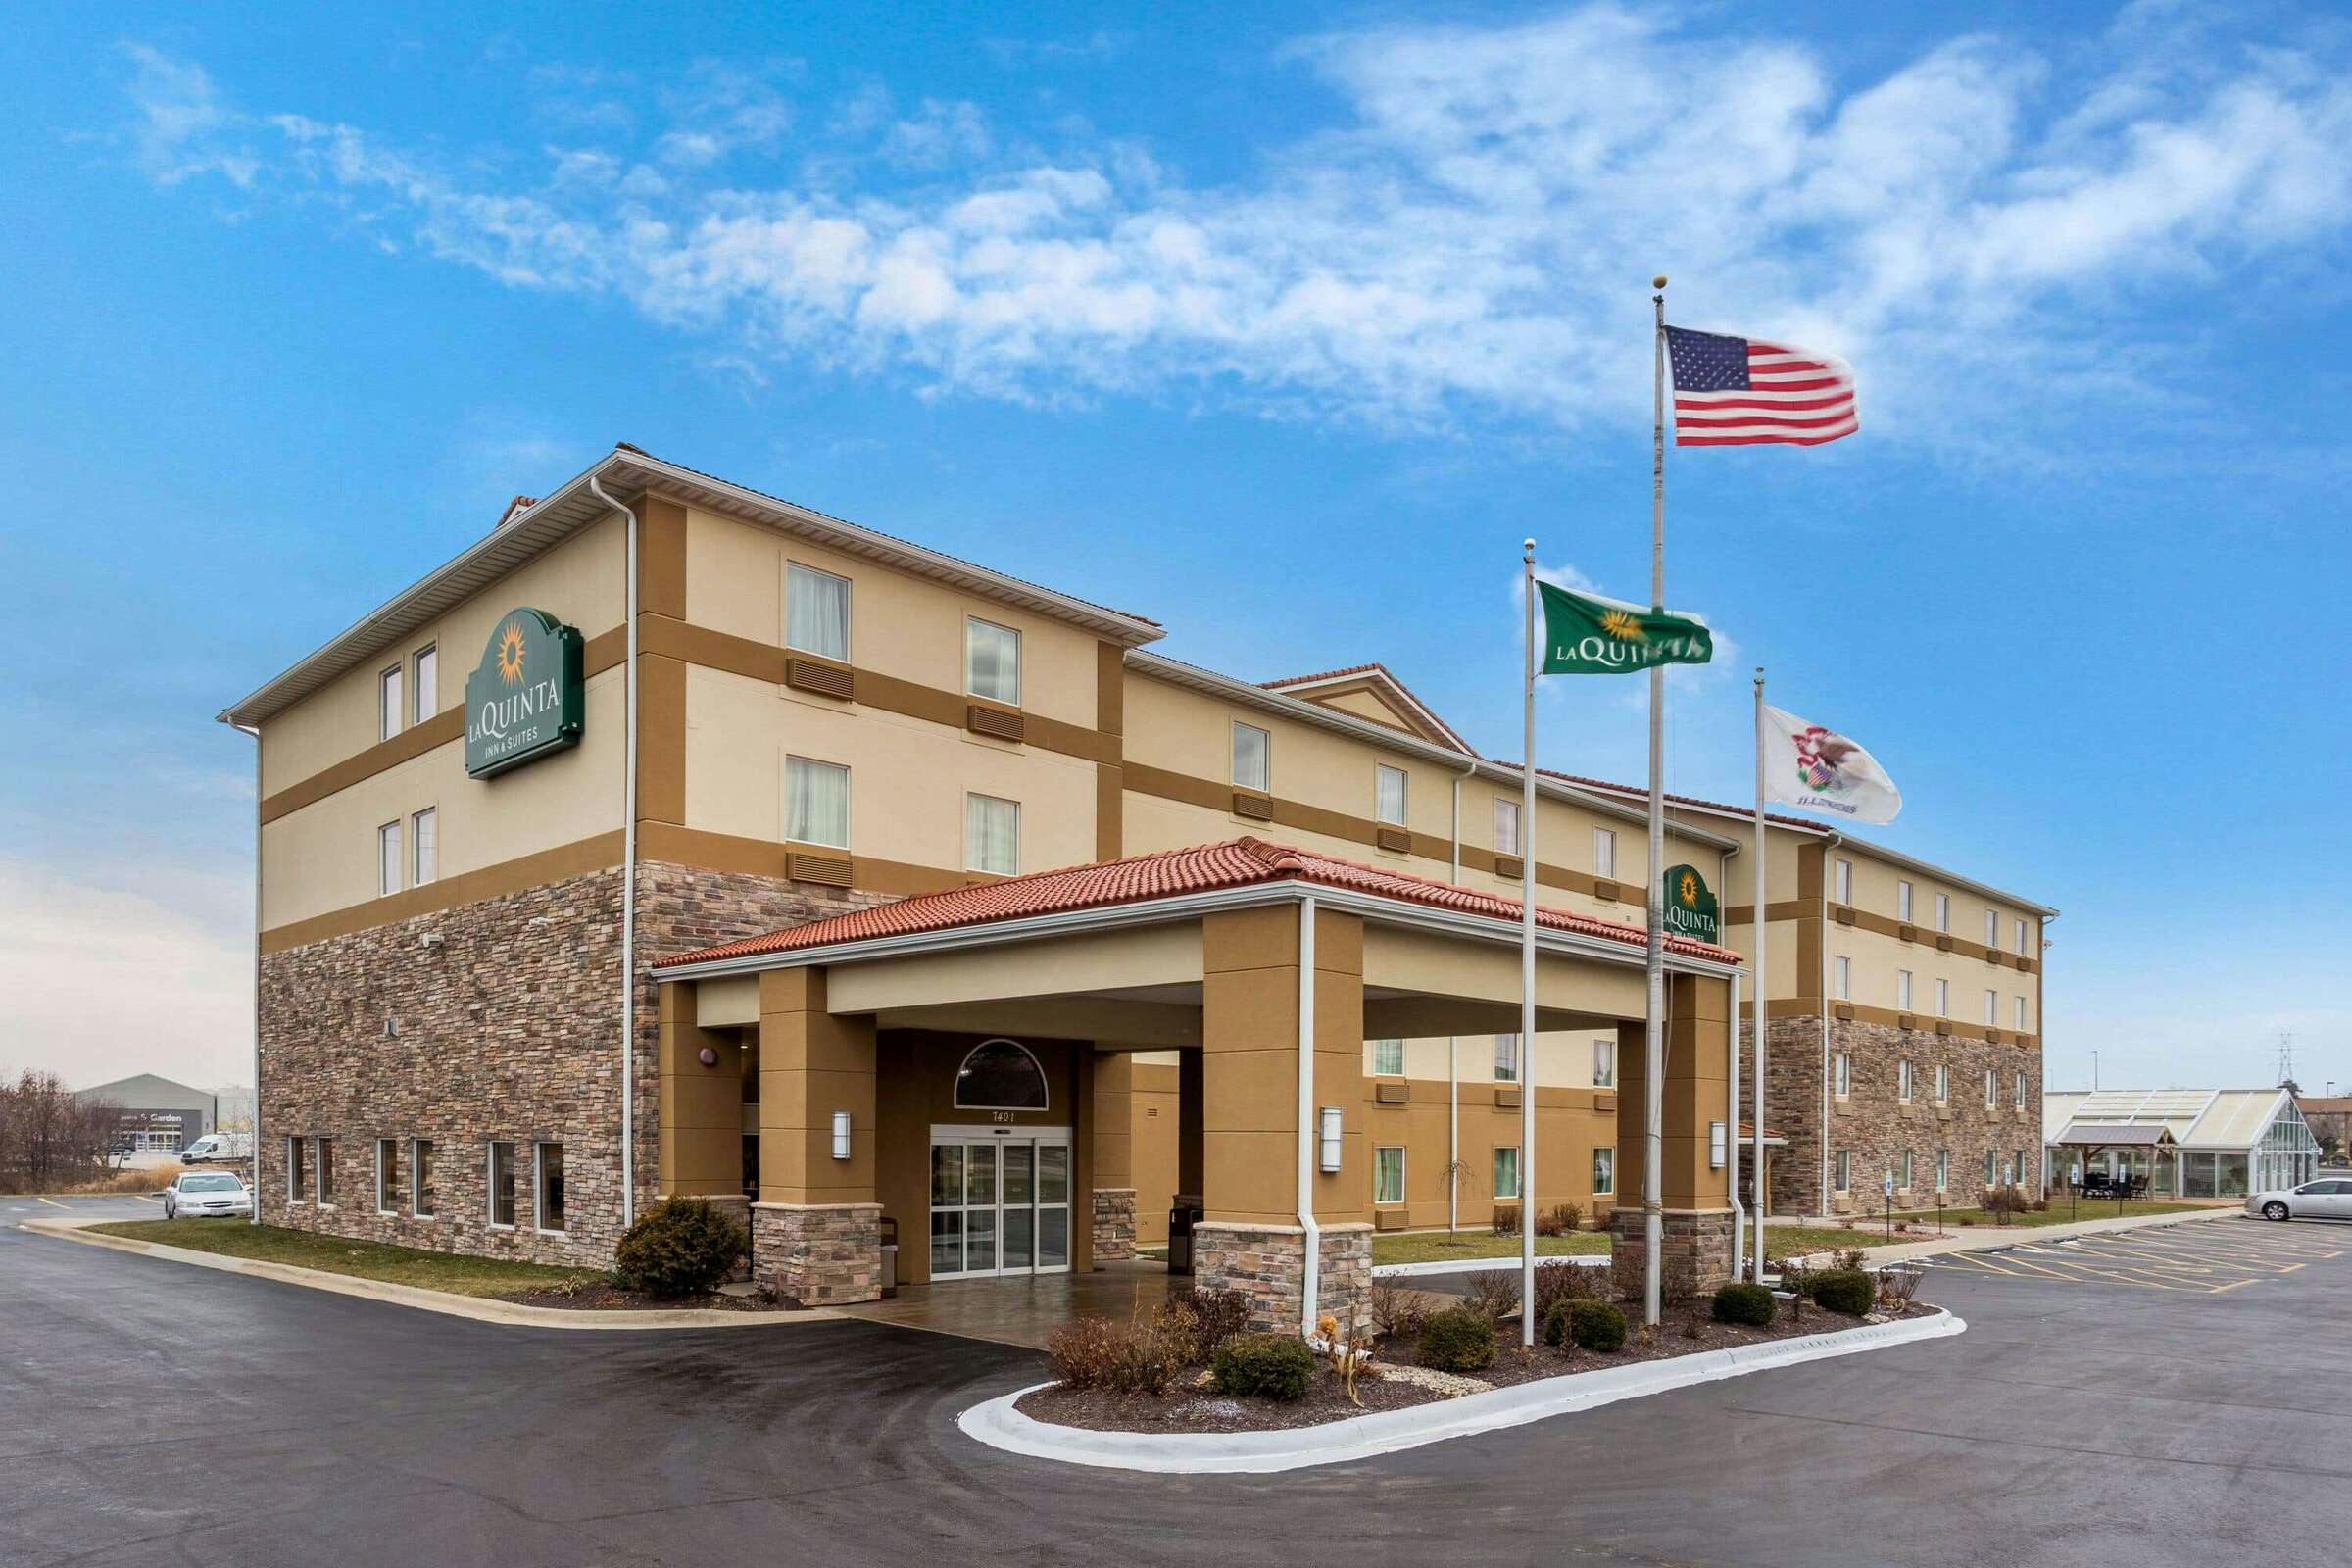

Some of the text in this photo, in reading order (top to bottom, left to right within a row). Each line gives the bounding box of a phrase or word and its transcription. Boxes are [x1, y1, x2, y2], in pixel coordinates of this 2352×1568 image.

[1556, 634, 1706, 667] LA QUINTA
[469, 677, 560, 743] LA QUINTA
[485, 743, 499, 759] INN
[507, 726, 538, 750] SUITES
[1670, 905, 1716, 933] QUINTA
[150, 1113, 182, 1122] Garden
